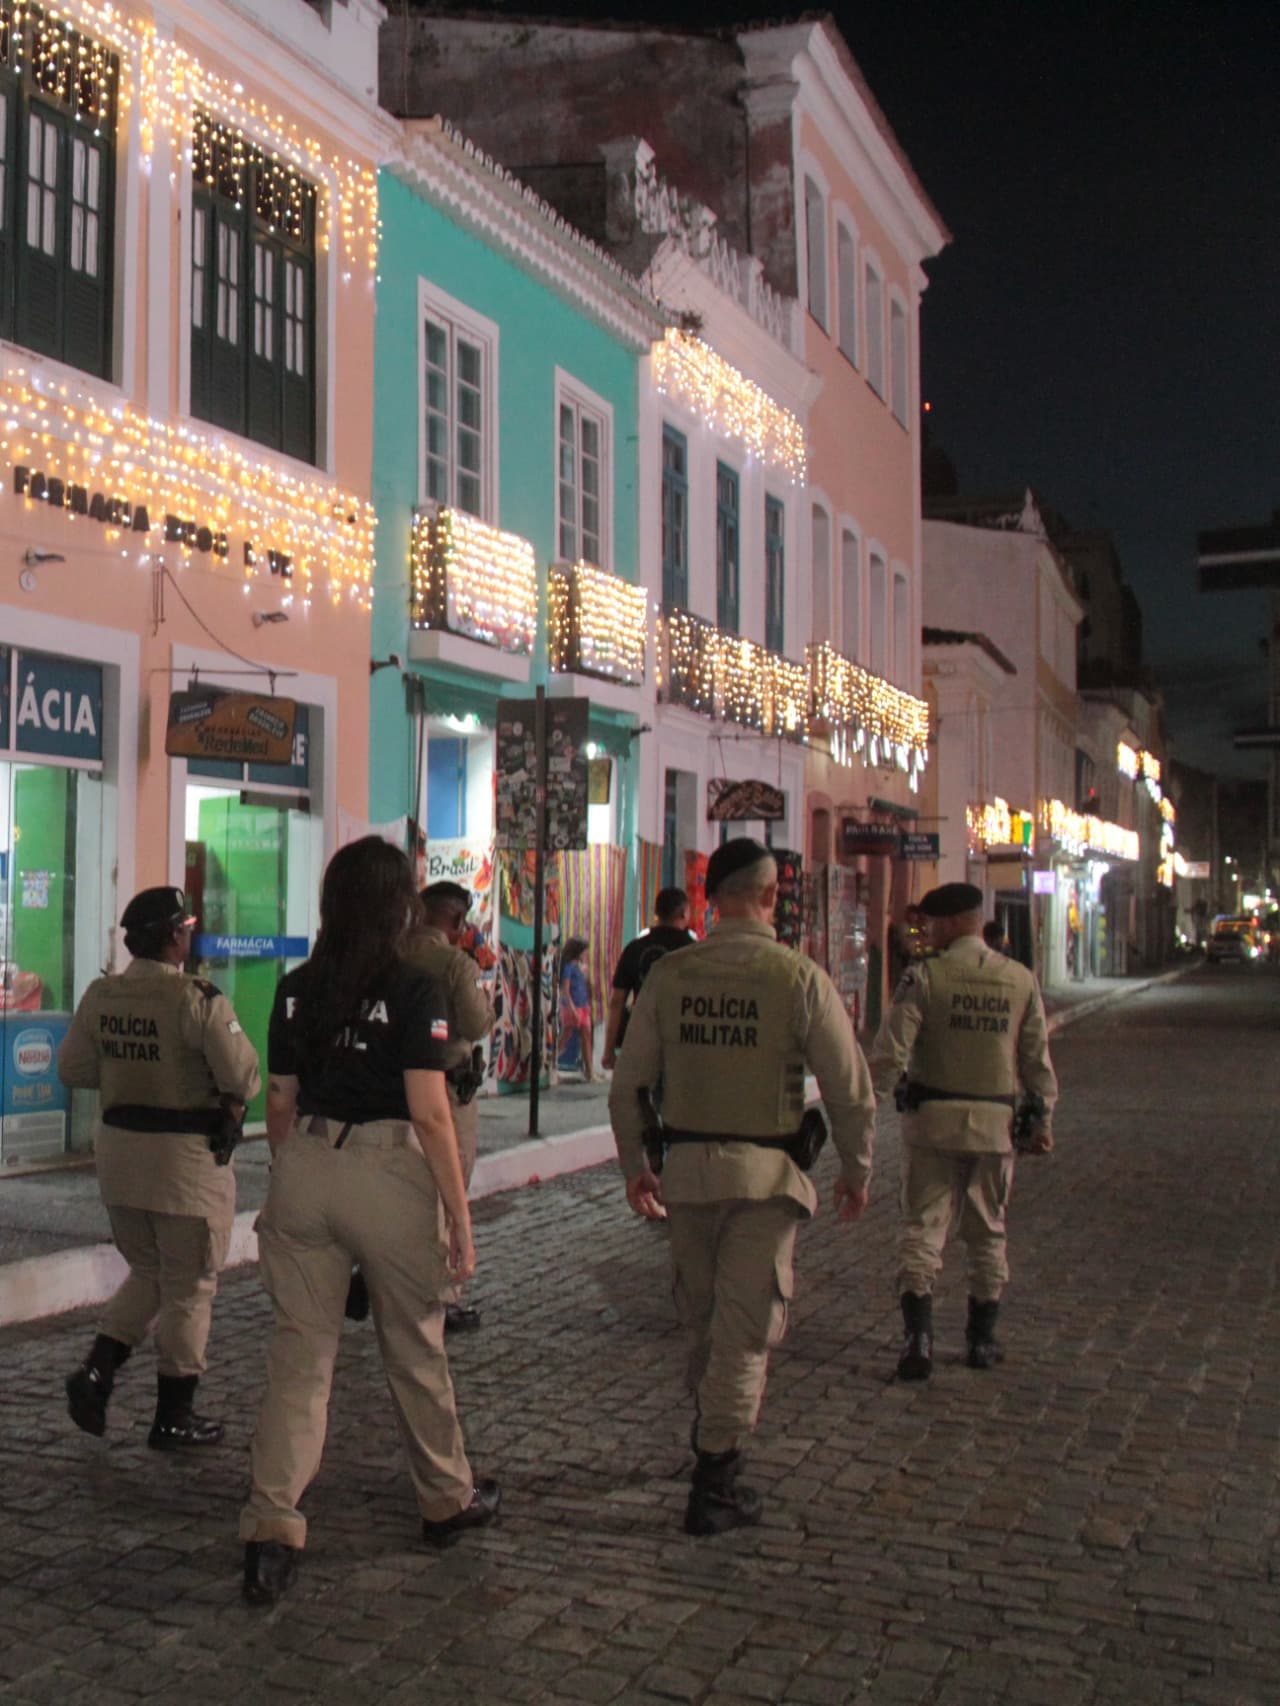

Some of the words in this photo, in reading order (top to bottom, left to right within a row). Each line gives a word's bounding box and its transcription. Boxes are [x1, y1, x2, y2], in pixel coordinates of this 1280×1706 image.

[429, 855, 477, 876] Brasil
[681, 993, 759, 1021] POLÍCIA
[952, 991, 1011, 1013] POLÍCIA
[100, 1011, 159, 1038] POLÍCIA
[949, 1014, 1010, 1033] MILITAR
[680, 1023, 758, 1047] MILITAR
[101, 1040, 161, 1062] MILITAR
